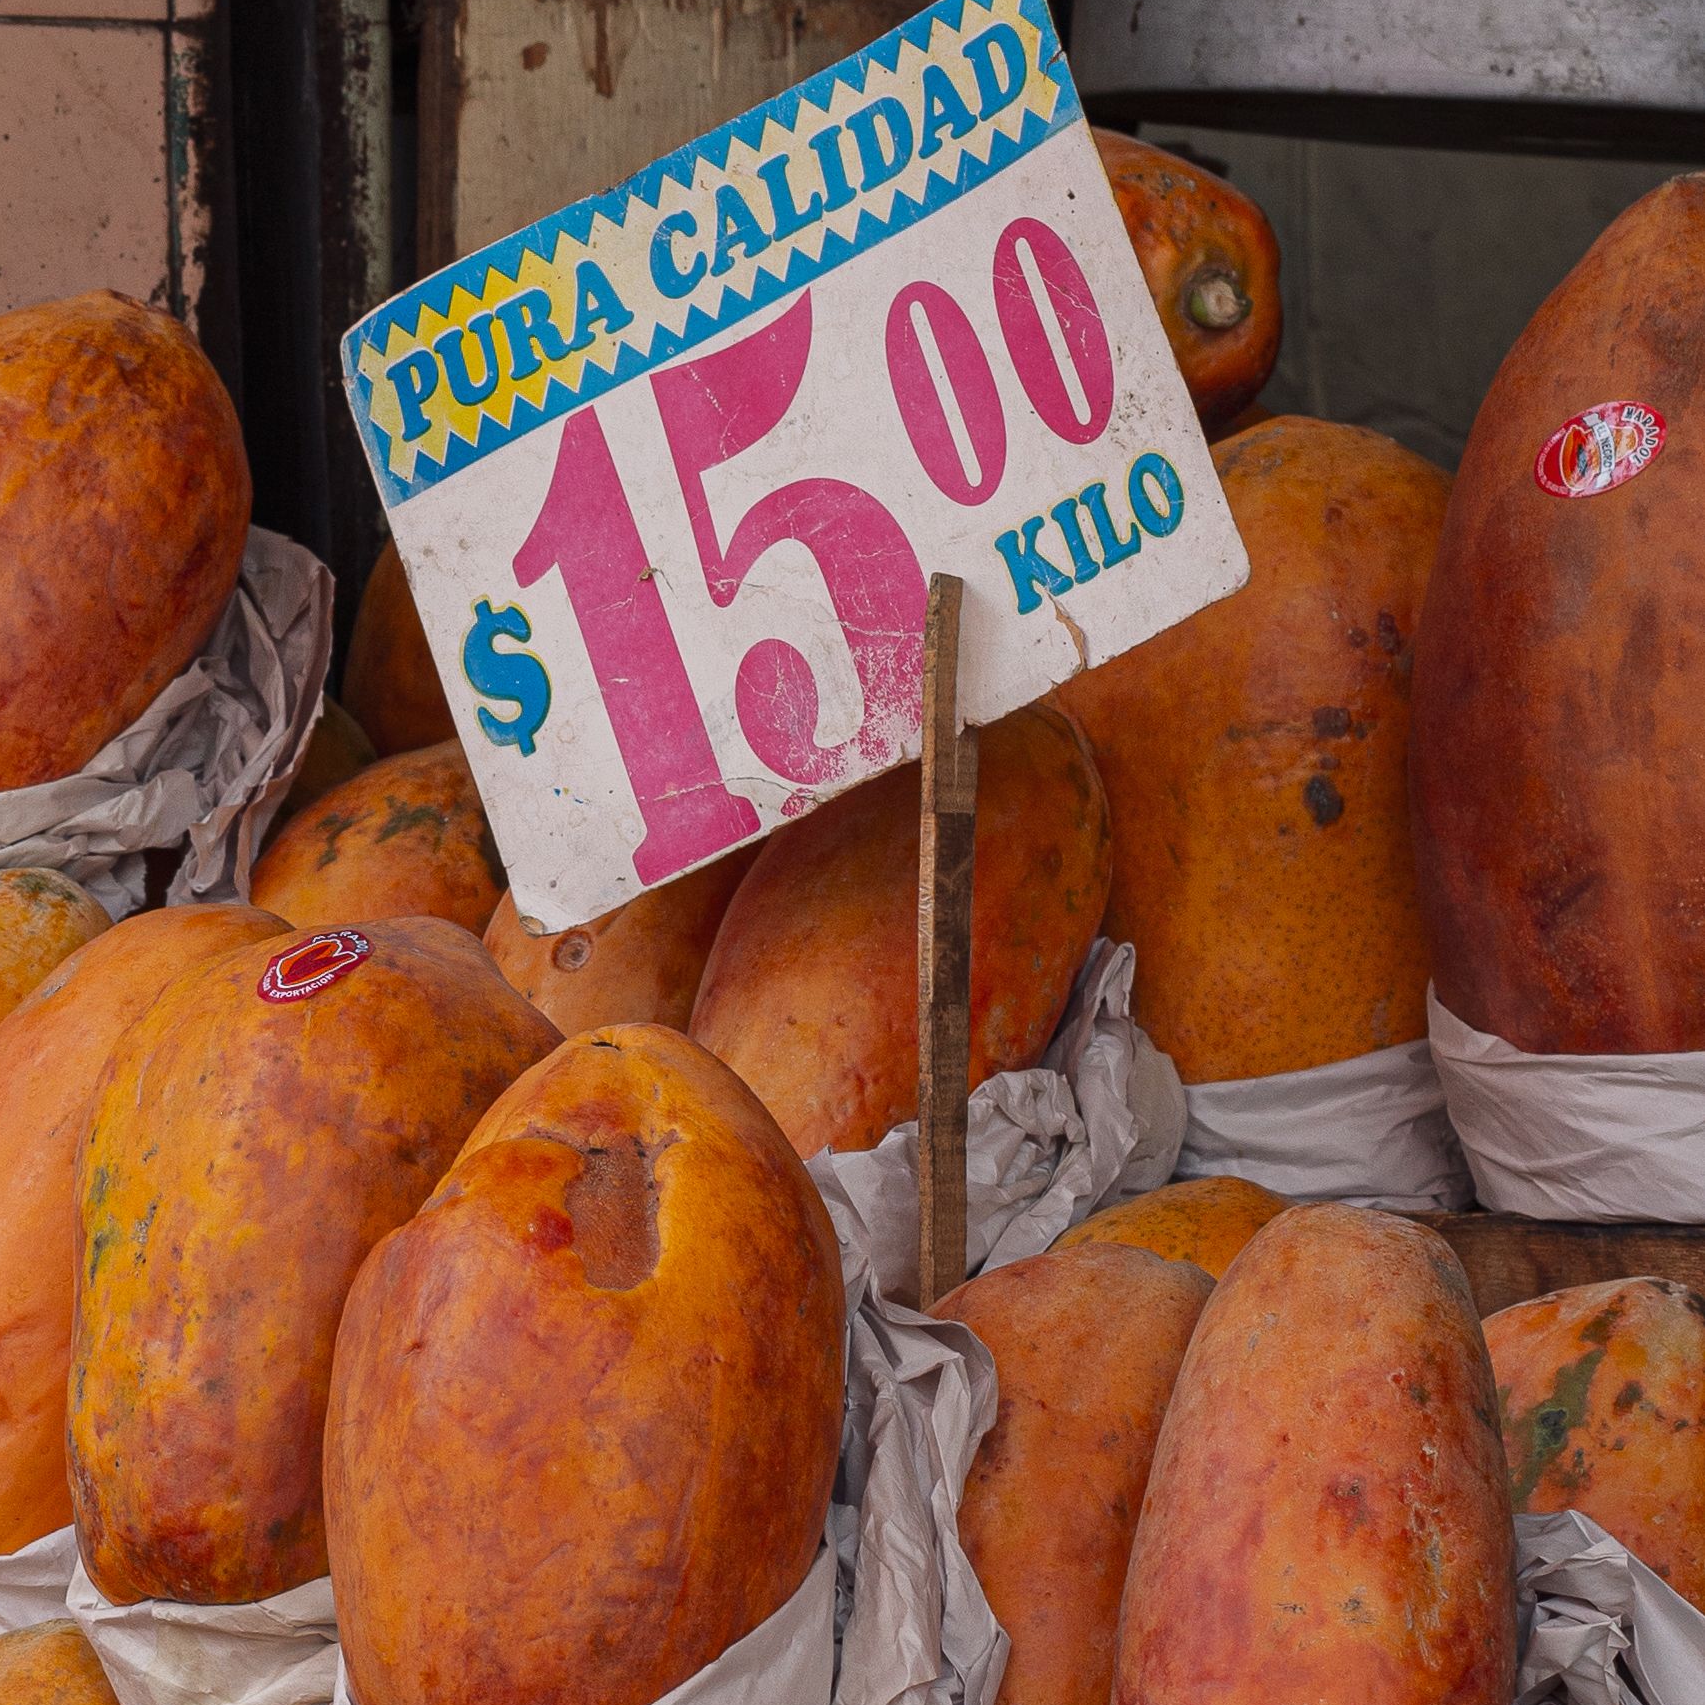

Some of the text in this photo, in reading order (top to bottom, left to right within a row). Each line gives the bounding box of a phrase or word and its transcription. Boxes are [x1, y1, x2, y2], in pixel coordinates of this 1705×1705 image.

[385, 21, 1031, 444] PURA CALIDAD
[1600, 436, 1614, 469] NEGRO
[1624, 406, 1659, 466] MARADOL
[993, 450, 1186, 616] KILO
[269, 973, 335, 999] EXPORTACION
